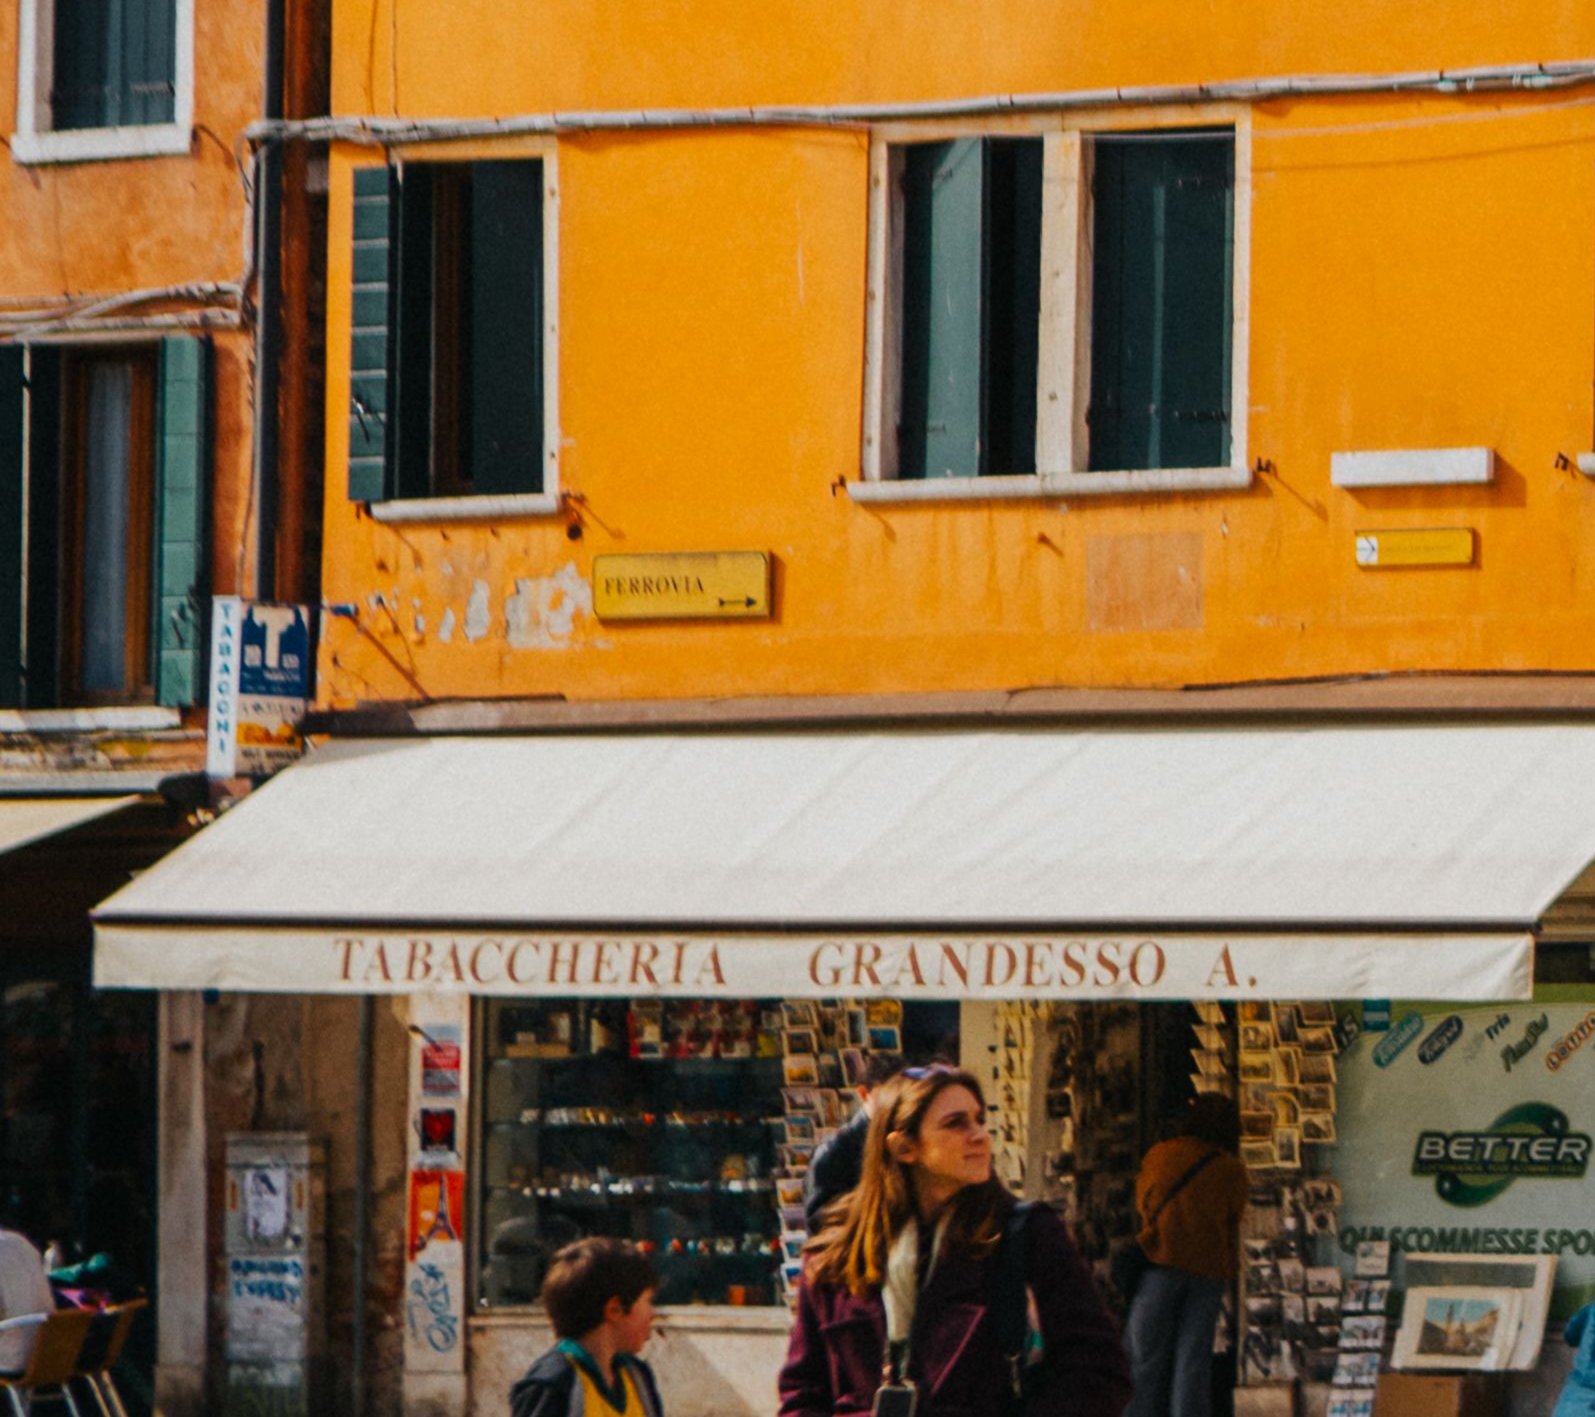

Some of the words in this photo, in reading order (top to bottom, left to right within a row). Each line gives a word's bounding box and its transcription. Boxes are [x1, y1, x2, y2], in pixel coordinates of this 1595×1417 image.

[604, 575, 704, 596] FERROVIA
[332, 937, 727, 985] TABACCHERIA
[808, 940, 1167, 987] GRANDESSO
[1205, 941, 1258, 988] A.
[1418, 1137, 1589, 1162] BETTER
[1389, 1227, 1538, 1254] SCOMMESSE
